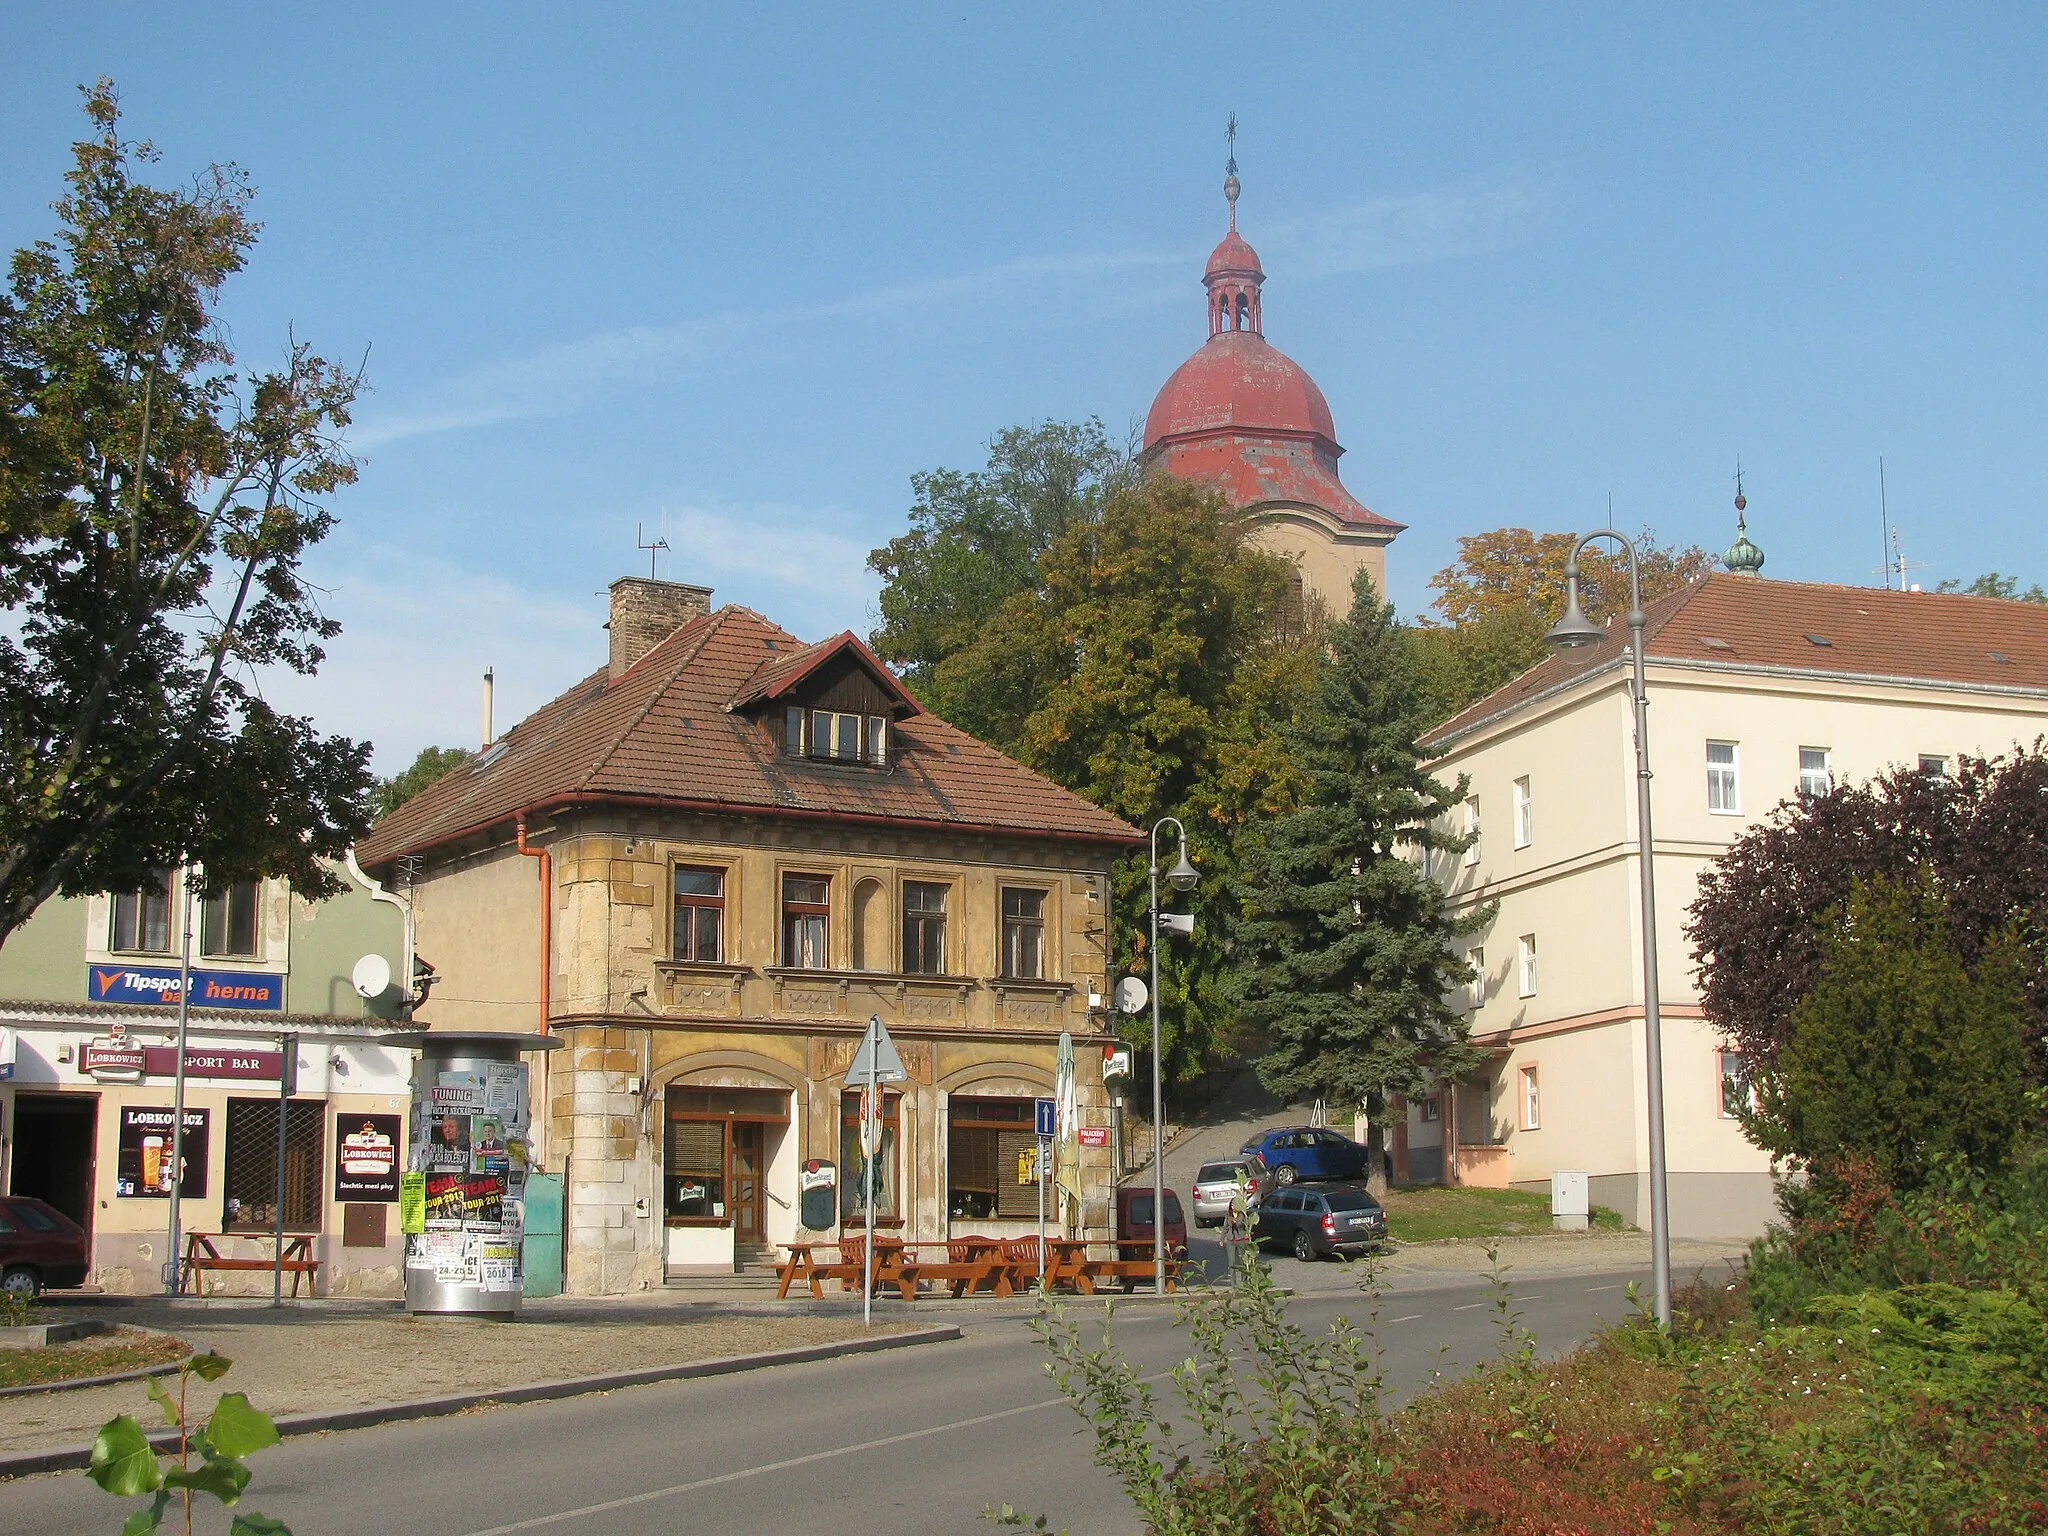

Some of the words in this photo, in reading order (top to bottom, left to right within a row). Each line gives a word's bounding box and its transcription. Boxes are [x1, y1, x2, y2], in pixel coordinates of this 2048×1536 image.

[124, 973, 194, 992] Tipspot
[161, 989, 190, 1003] ba
[206, 981, 269, 1000] herna
[90, 1053, 144, 1064] LOBKOWICZ
[232, 1059, 260, 1069] BAR
[433, 1089, 472, 1101] TUNING
[128, 1112, 204, 1125] LOBKOICZ
[344, 1150, 391, 1158] LOBKOWICZ
